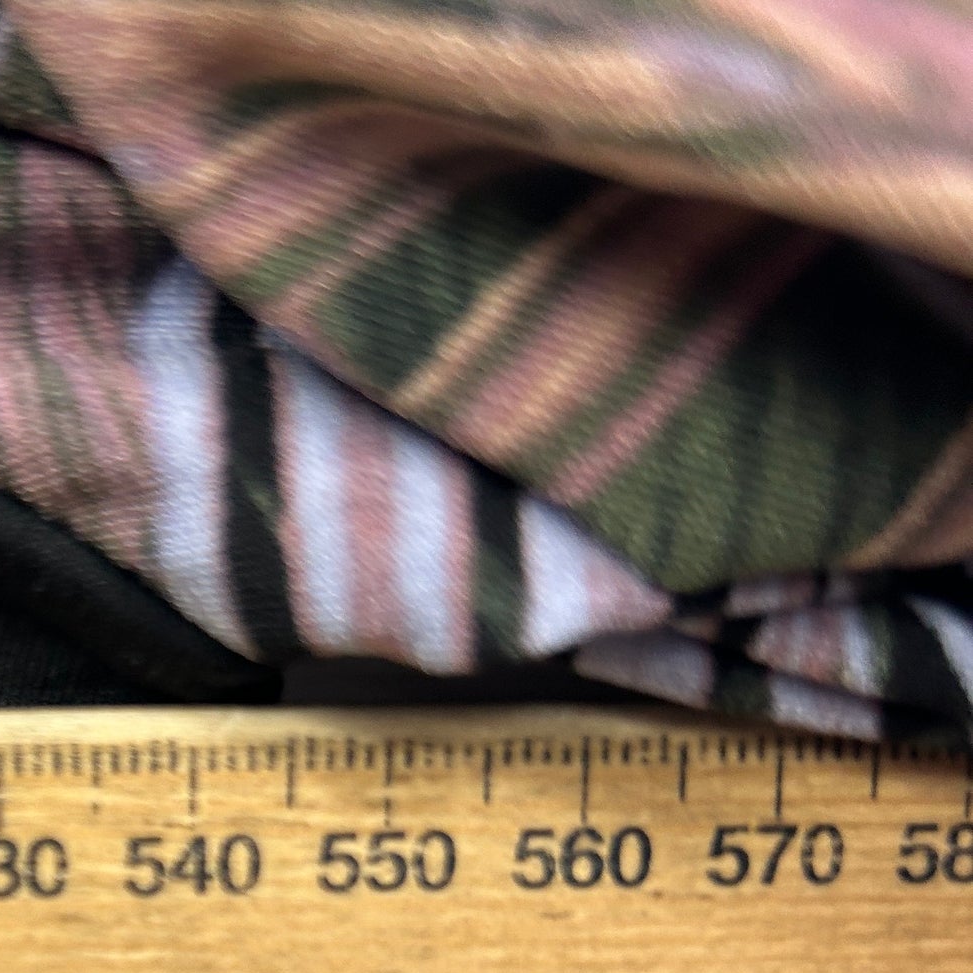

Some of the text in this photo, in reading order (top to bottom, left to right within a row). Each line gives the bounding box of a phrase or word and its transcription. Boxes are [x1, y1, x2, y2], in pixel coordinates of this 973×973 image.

[123, 834, 261, 896] 540
[316, 829, 456, 893] 550
[512, 826, 651, 890] 560
[706, 823, 844, 886] 570
